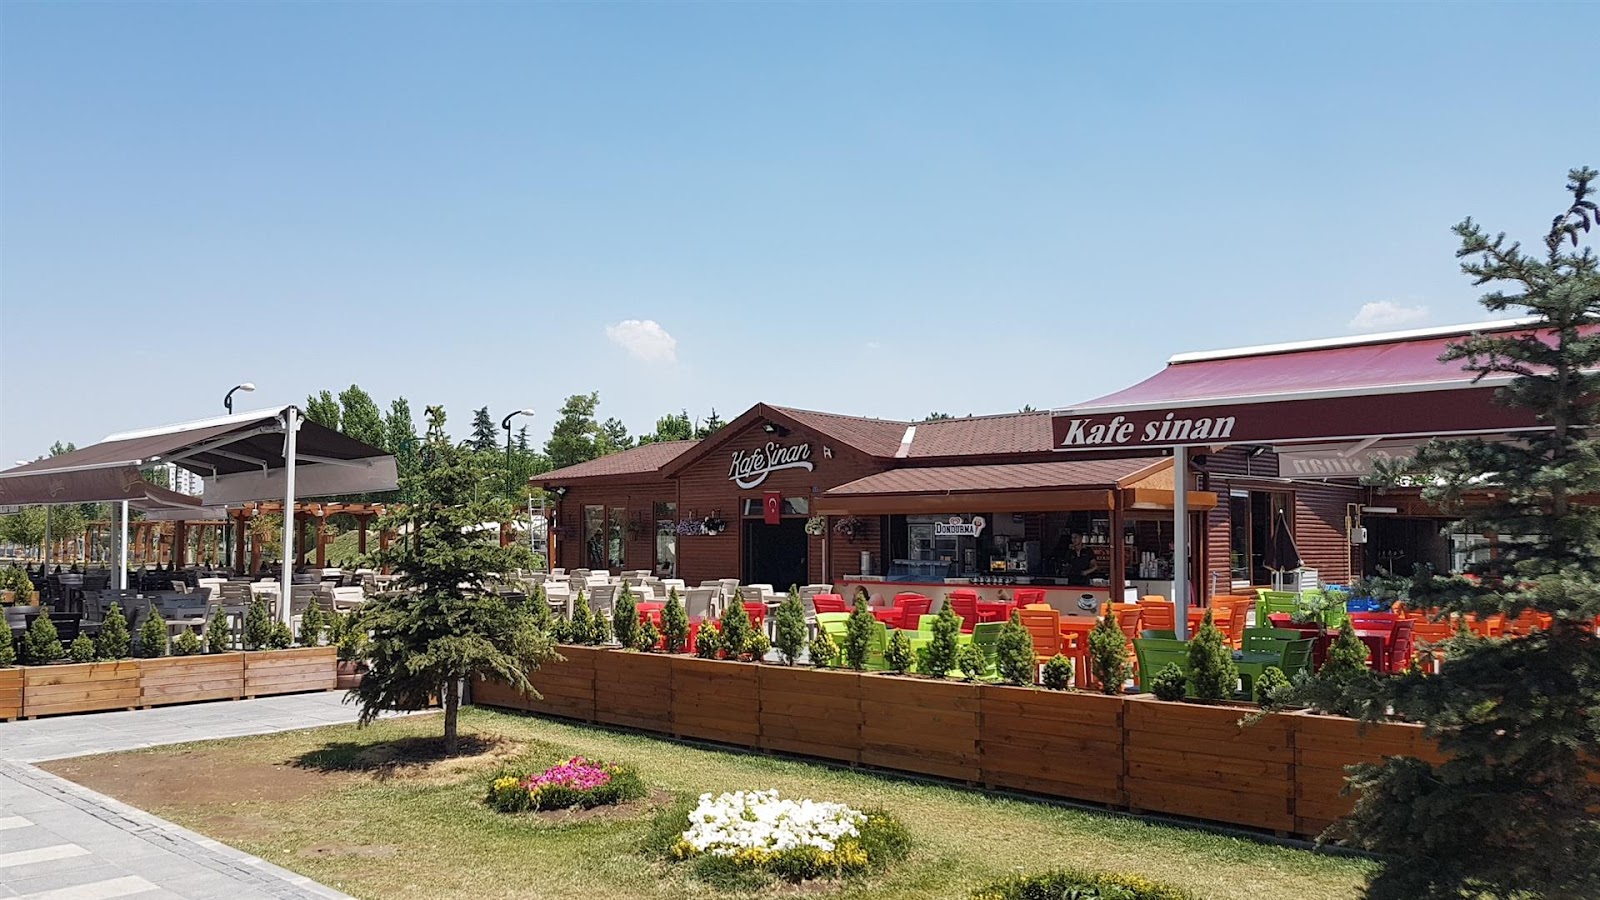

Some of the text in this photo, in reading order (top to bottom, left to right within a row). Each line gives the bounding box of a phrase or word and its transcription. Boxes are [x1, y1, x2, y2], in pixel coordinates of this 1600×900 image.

[1060, 412, 1236, 446] Kafe sinan
[728, 441, 811, 478] Kafe Sinan
[936, 523, 975, 534] DONDURMA
